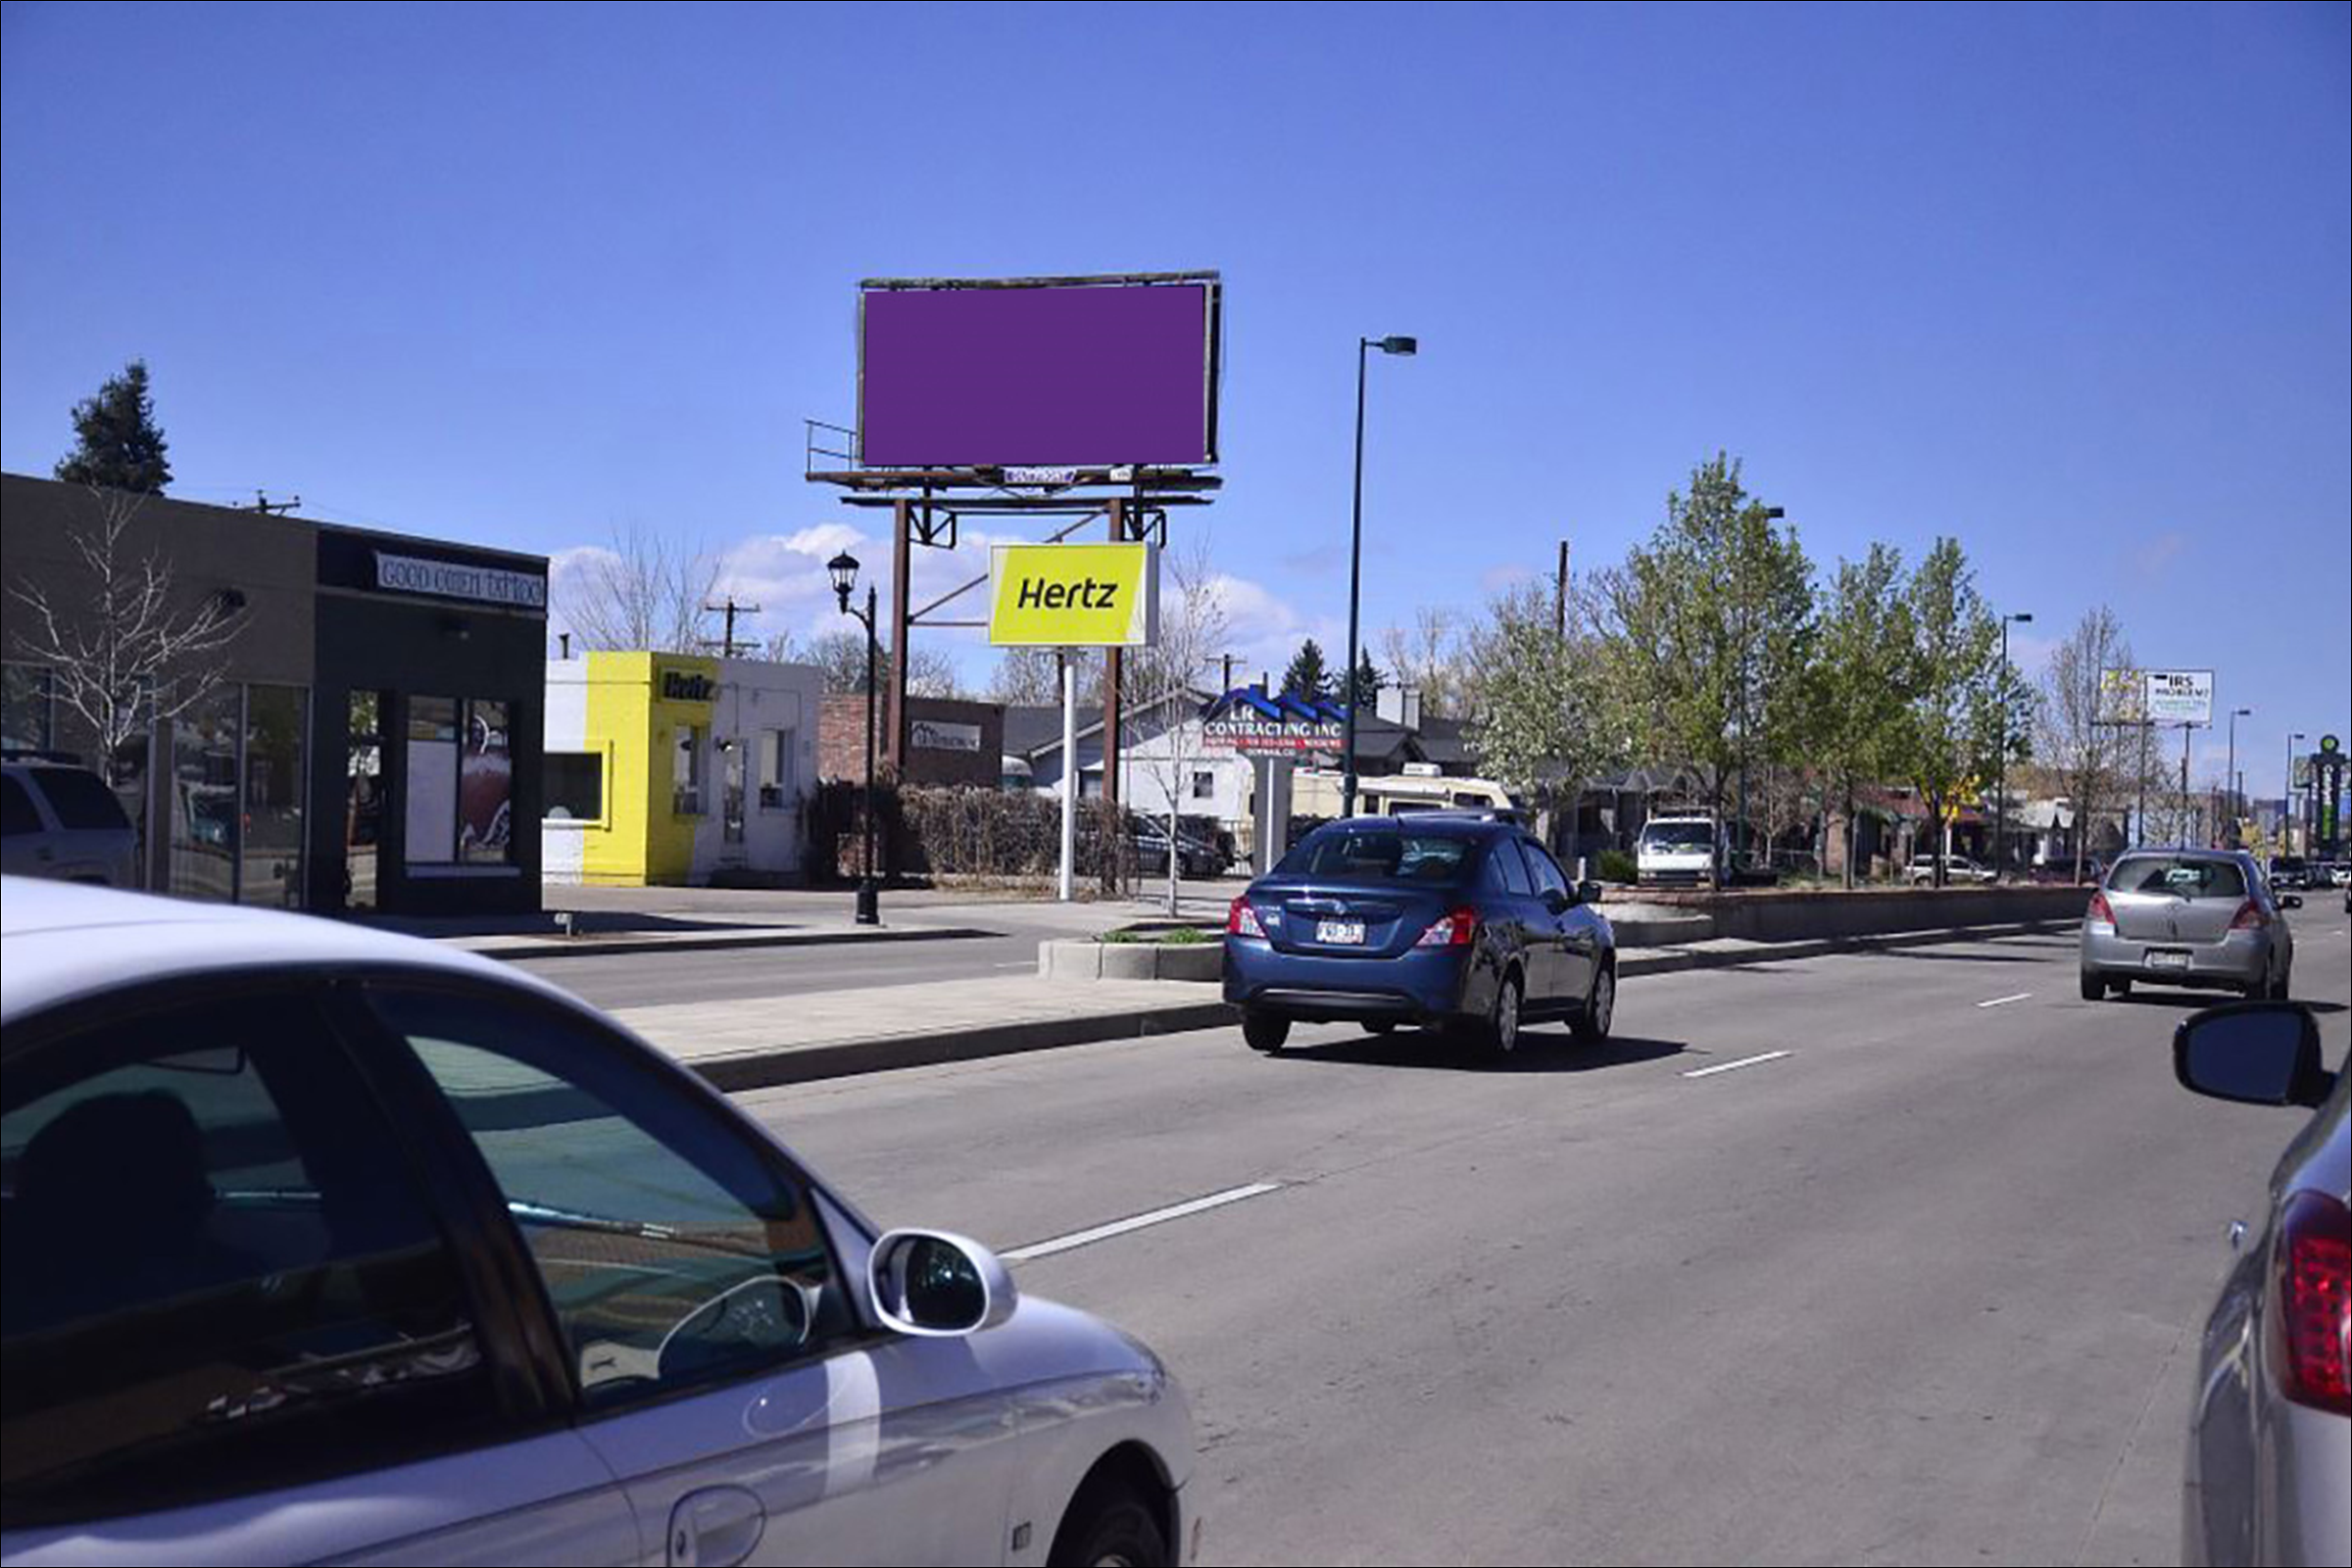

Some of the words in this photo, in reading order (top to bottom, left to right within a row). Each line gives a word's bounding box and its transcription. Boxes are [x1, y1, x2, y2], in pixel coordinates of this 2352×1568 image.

[382, 561, 429, 588] GOOD
[1017, 577, 1118, 609] Hertz
[2169, 674, 2194, 688] IRS
[1204, 722, 1310, 736] CONTRACTING
